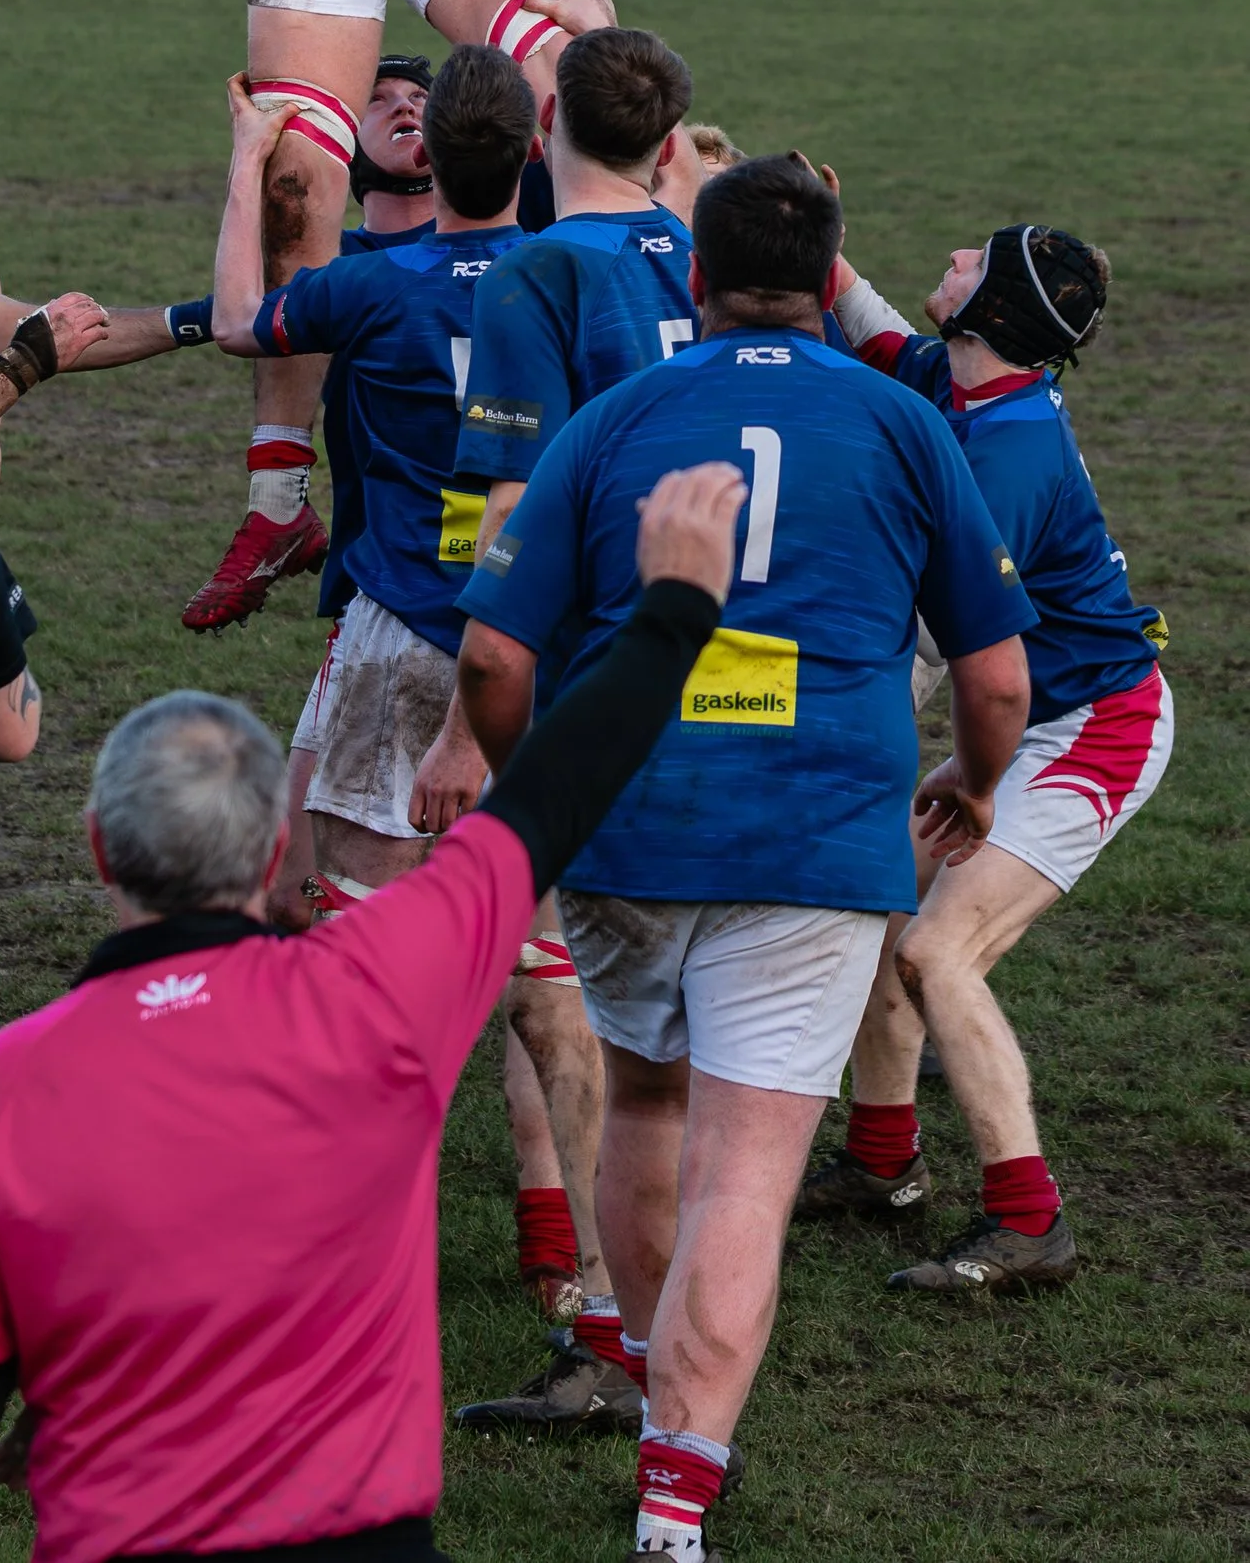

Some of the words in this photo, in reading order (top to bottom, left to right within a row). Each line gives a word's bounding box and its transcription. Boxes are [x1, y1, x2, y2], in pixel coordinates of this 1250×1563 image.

[736, 346, 792, 364] RCS
[485, 409, 514, 421] Belton
[515, 412, 538, 425] Farm
[741, 426, 782, 584] 1
[693, 691, 787, 713] gaskells
